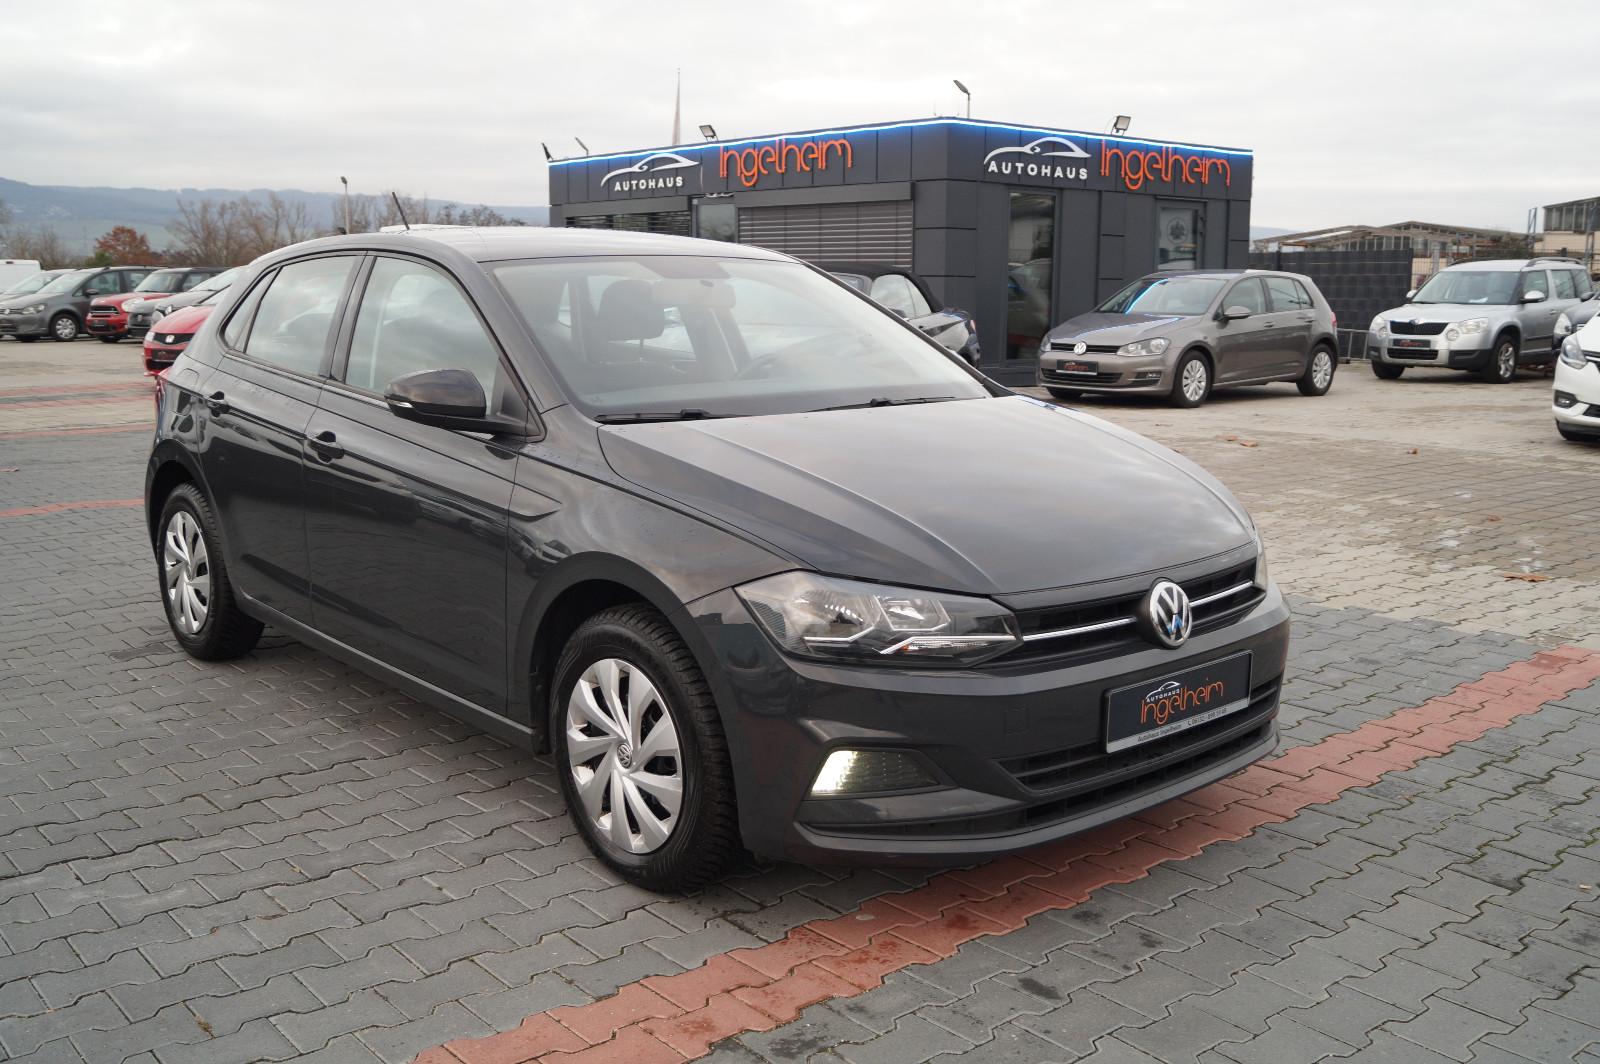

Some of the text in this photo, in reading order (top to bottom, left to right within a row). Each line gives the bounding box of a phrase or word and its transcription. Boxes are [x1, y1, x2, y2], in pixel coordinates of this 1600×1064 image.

[614, 138, 853, 192] AUTOHAUS Ingelheim
[987, 138, 1231, 191] AUTOHAUS Ingelheim
[1140, 681, 1224, 726] Ingelheim
[1146, 688, 1181, 703] AUTOHAUS
